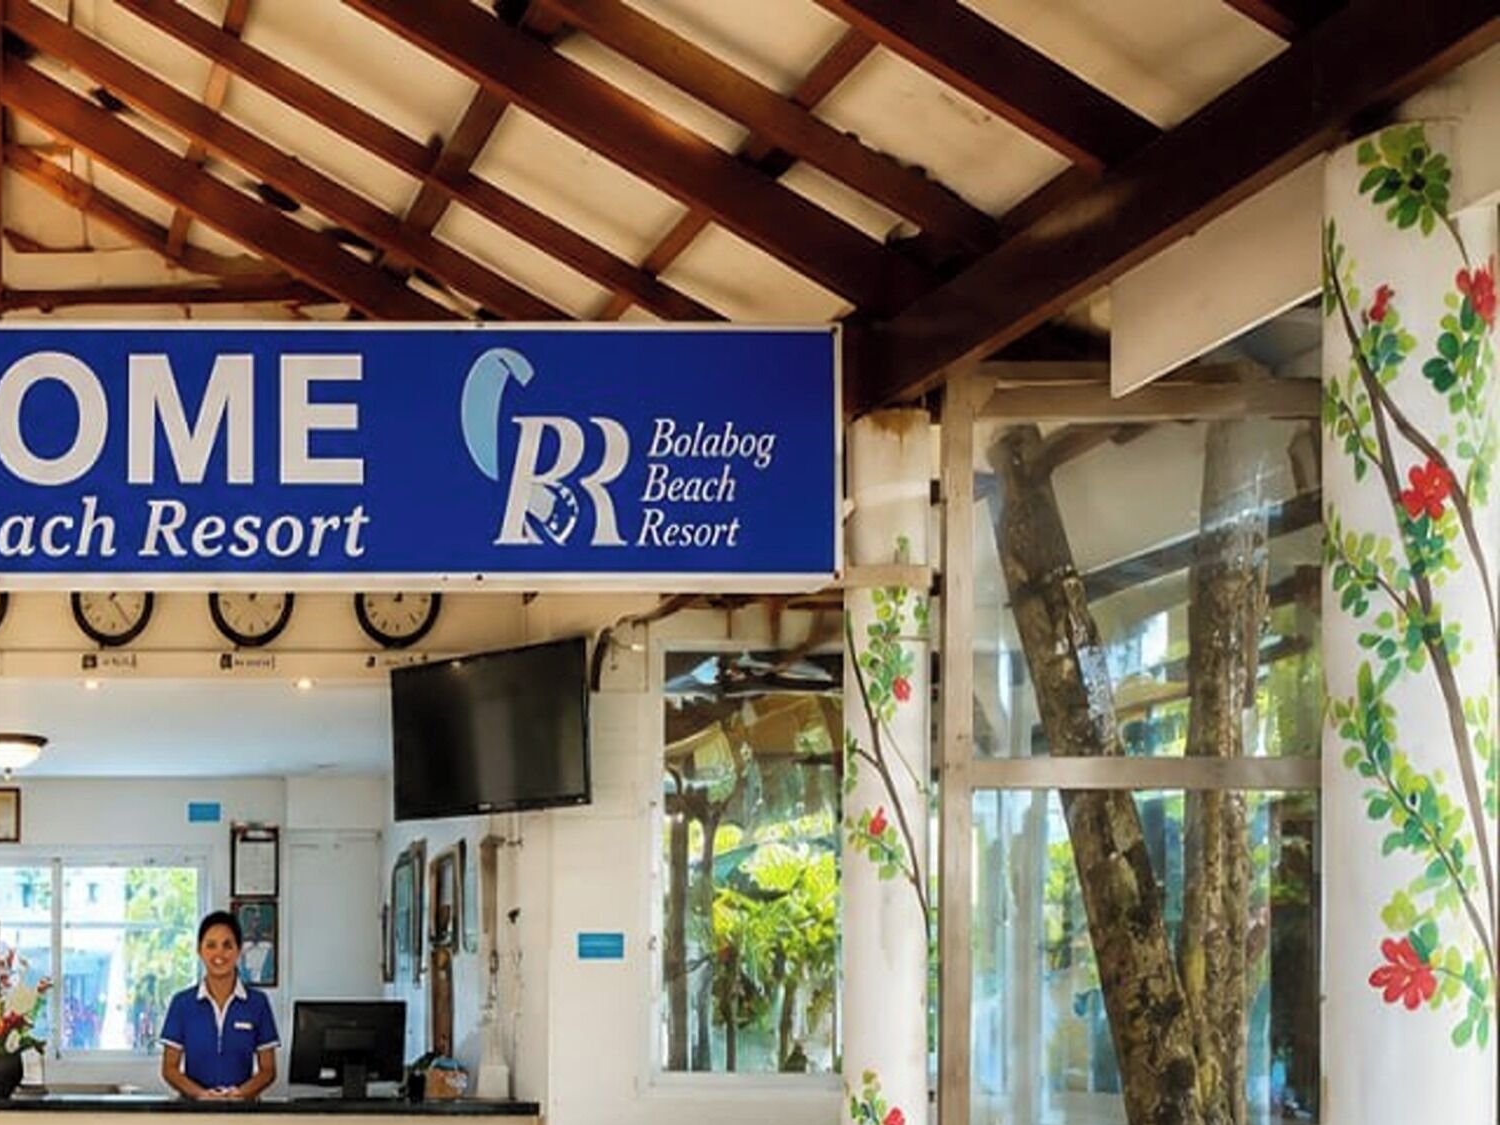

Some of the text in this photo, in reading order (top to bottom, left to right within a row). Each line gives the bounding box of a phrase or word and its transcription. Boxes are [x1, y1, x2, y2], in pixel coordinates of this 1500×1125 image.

[648, 417, 776, 469] Bolabog
[640, 463, 737, 503] Beach
[138, 499, 370, 557] Resort
[635, 508, 741, 547] Resort
